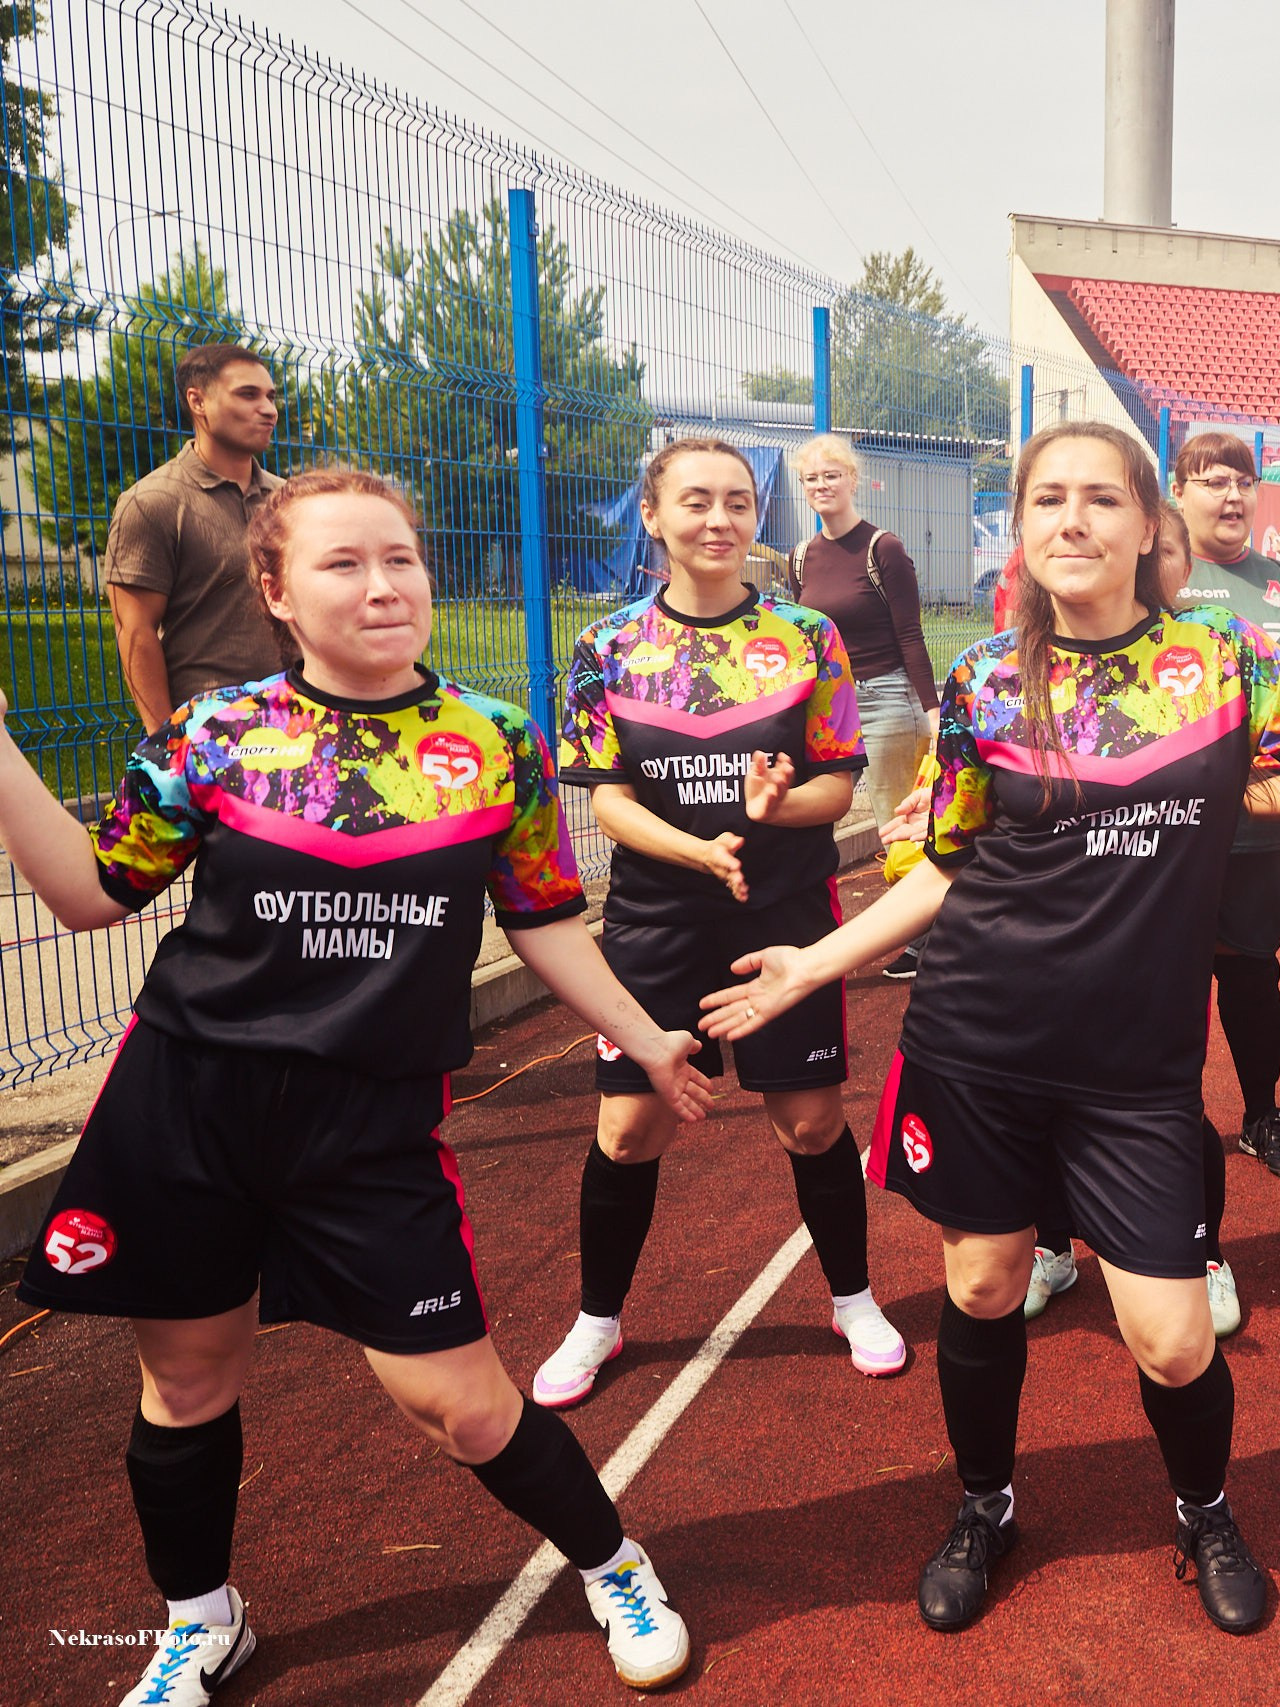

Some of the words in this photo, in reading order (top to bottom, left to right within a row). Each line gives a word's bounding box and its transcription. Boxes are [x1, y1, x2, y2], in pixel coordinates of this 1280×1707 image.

[745, 653, 787, 678] 52
[1158, 663, 1203, 697] 52
[422, 753, 479, 790] 52
[640, 752, 774, 780] ФУТБОЛЬНЕ
[677, 779, 740, 805] МАМЫ
[1085, 829, 1160, 857] МАМЫ
[253, 890, 450, 927] ФУТБОЛЬНЫЕ
[301, 928, 395, 960] МАМЫ
[903, 1131, 930, 1174] 52
[45, 1230, 108, 1274] 52
